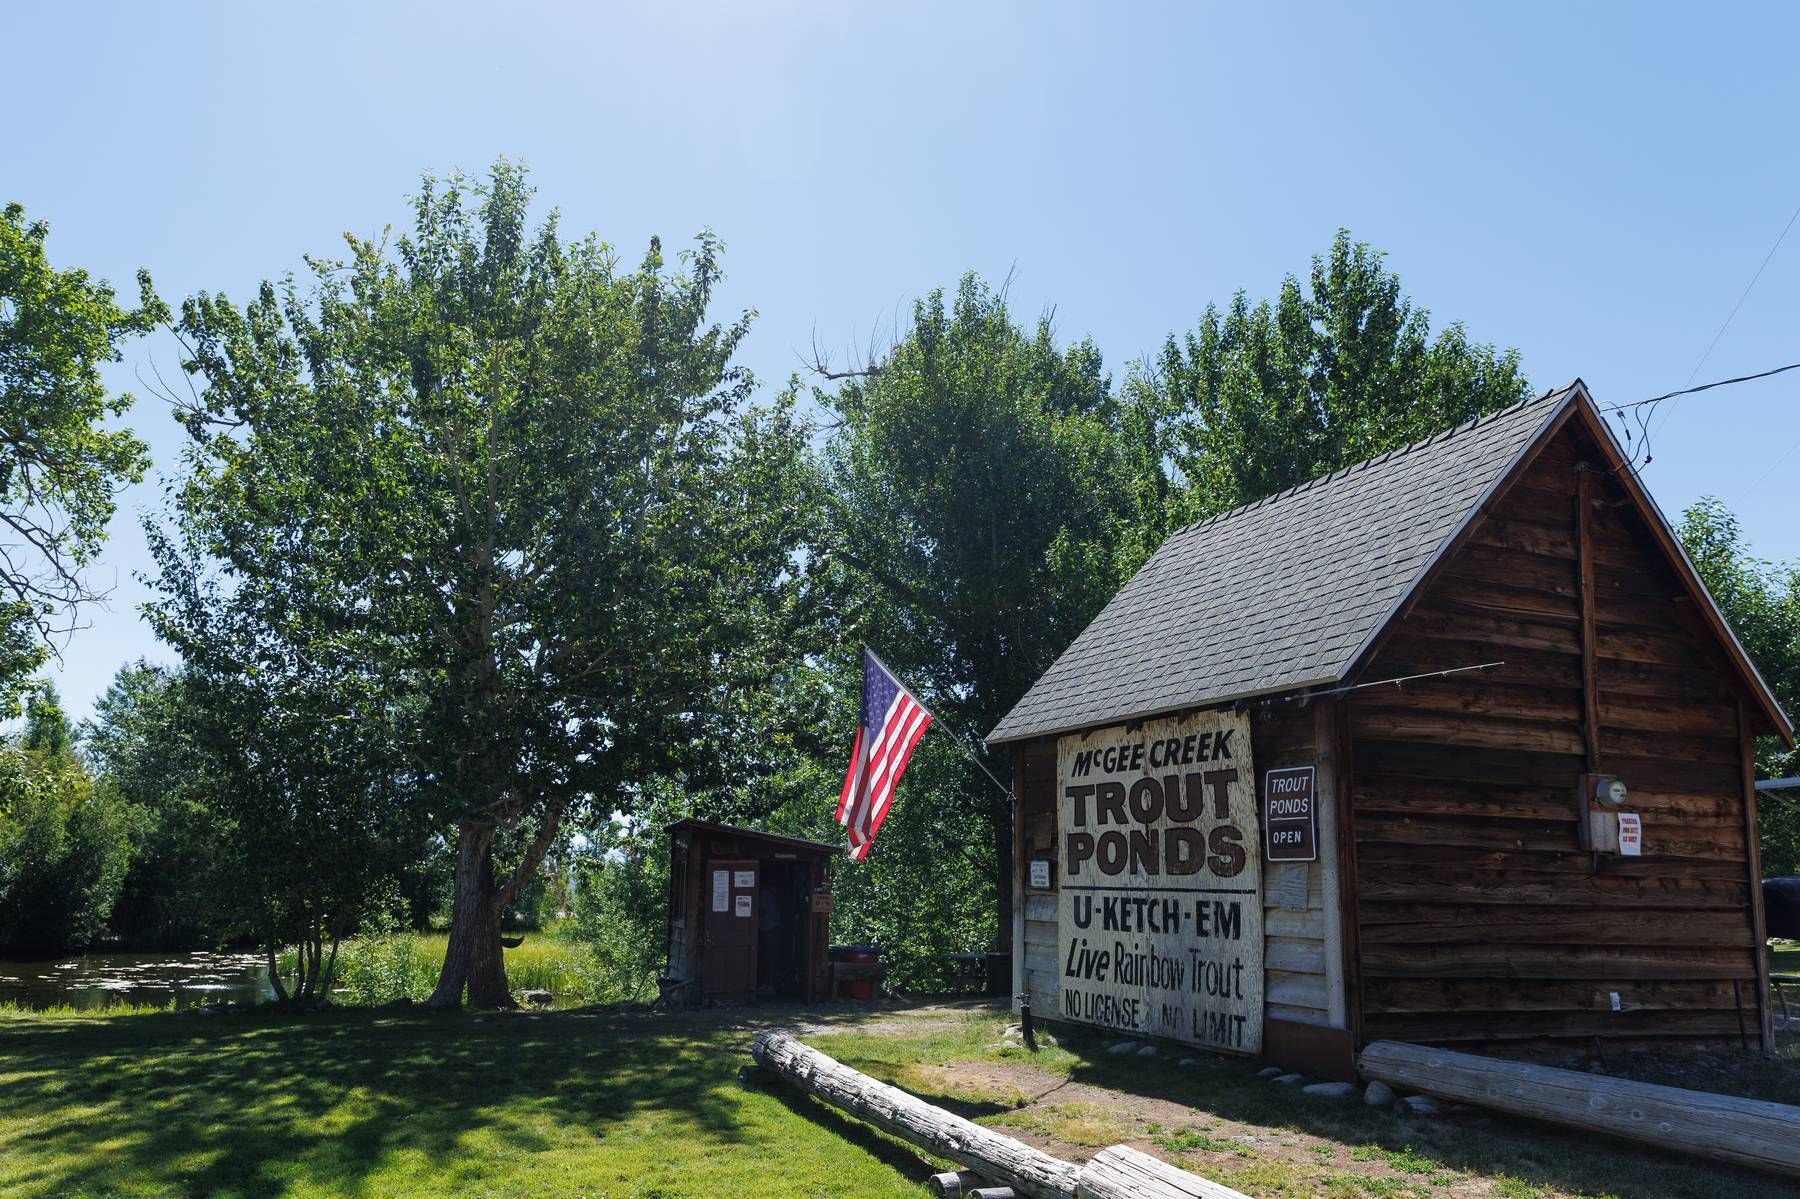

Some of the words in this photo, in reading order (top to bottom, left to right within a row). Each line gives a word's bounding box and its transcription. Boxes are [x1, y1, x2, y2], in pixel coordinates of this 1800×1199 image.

[1150, 729, 1236, 768] CREEK
[1065, 768, 1239, 827] TROUT
[1270, 798, 1309, 815] PONDS
[1271, 776, 1310, 793] TROUT
[1067, 825, 1246, 878] PONDS
[1273, 831, 1302, 844] OPEN
[1073, 895, 1242, 940] U-KETCH-EM
[1065, 937, 1111, 983] Live
[1114, 941, 1185, 991] Rainbow
[1189, 948, 1245, 1000] Trout
[1065, 988, 1082, 1018] NO
[1084, 992, 1140, 1029] LICENSE
[1161, 1003, 1186, 1030] NO
[1193, 1009, 1247, 1048] LIMIT
